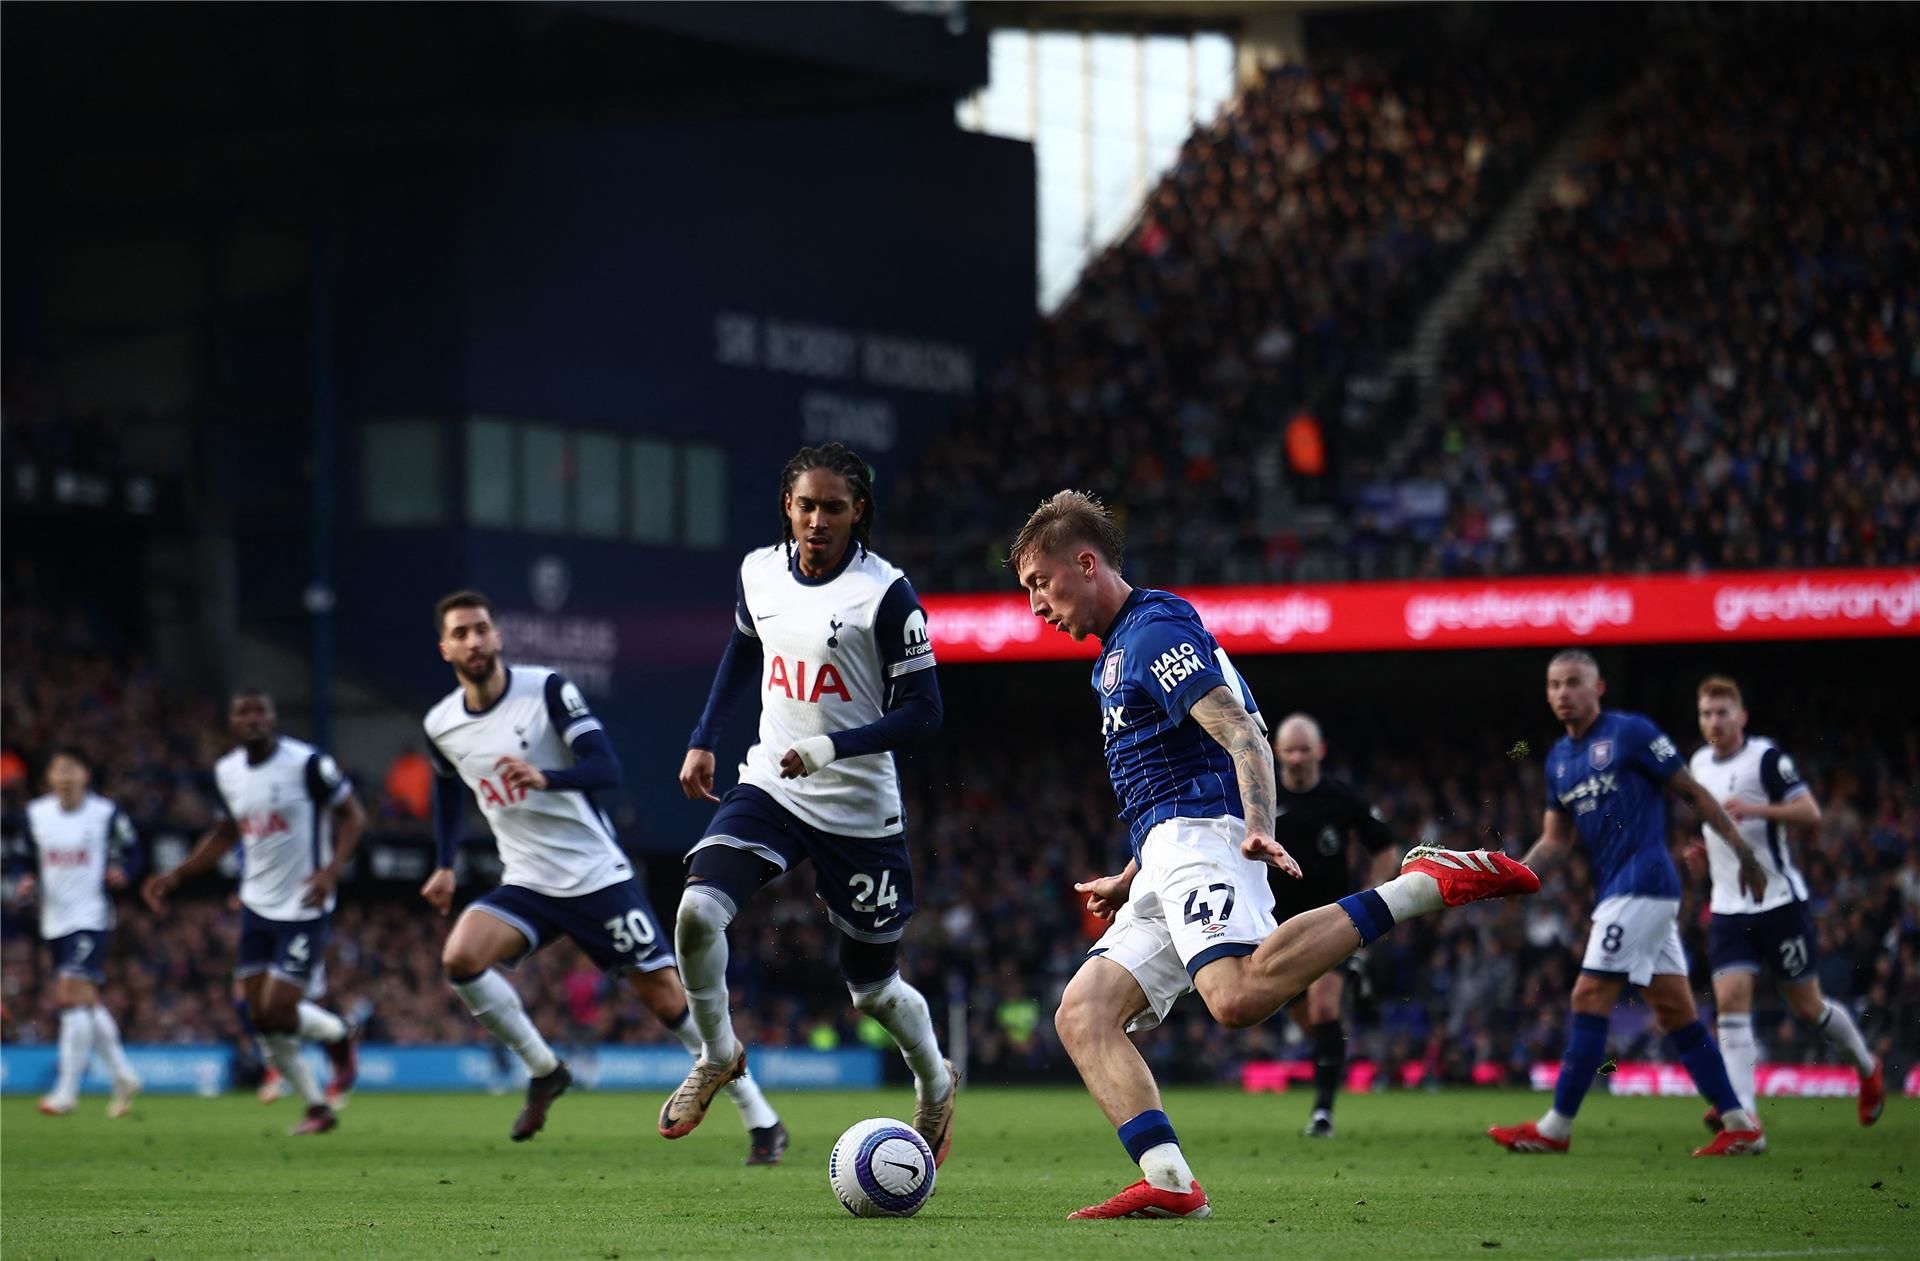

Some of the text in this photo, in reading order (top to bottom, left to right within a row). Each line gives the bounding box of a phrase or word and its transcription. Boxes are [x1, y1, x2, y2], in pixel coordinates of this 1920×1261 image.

[768, 655, 852, 703] AIA
[1150, 642, 1195, 678] HALO
[1158, 654, 1206, 694] ITSM
[848, 869, 899, 913] 24
[1184, 883, 1236, 926] 47
[286, 933, 312, 962] 4
[604, 908, 656, 953] 30
[1602, 924, 1624, 952] 8
[1779, 935, 1808, 970] 21
